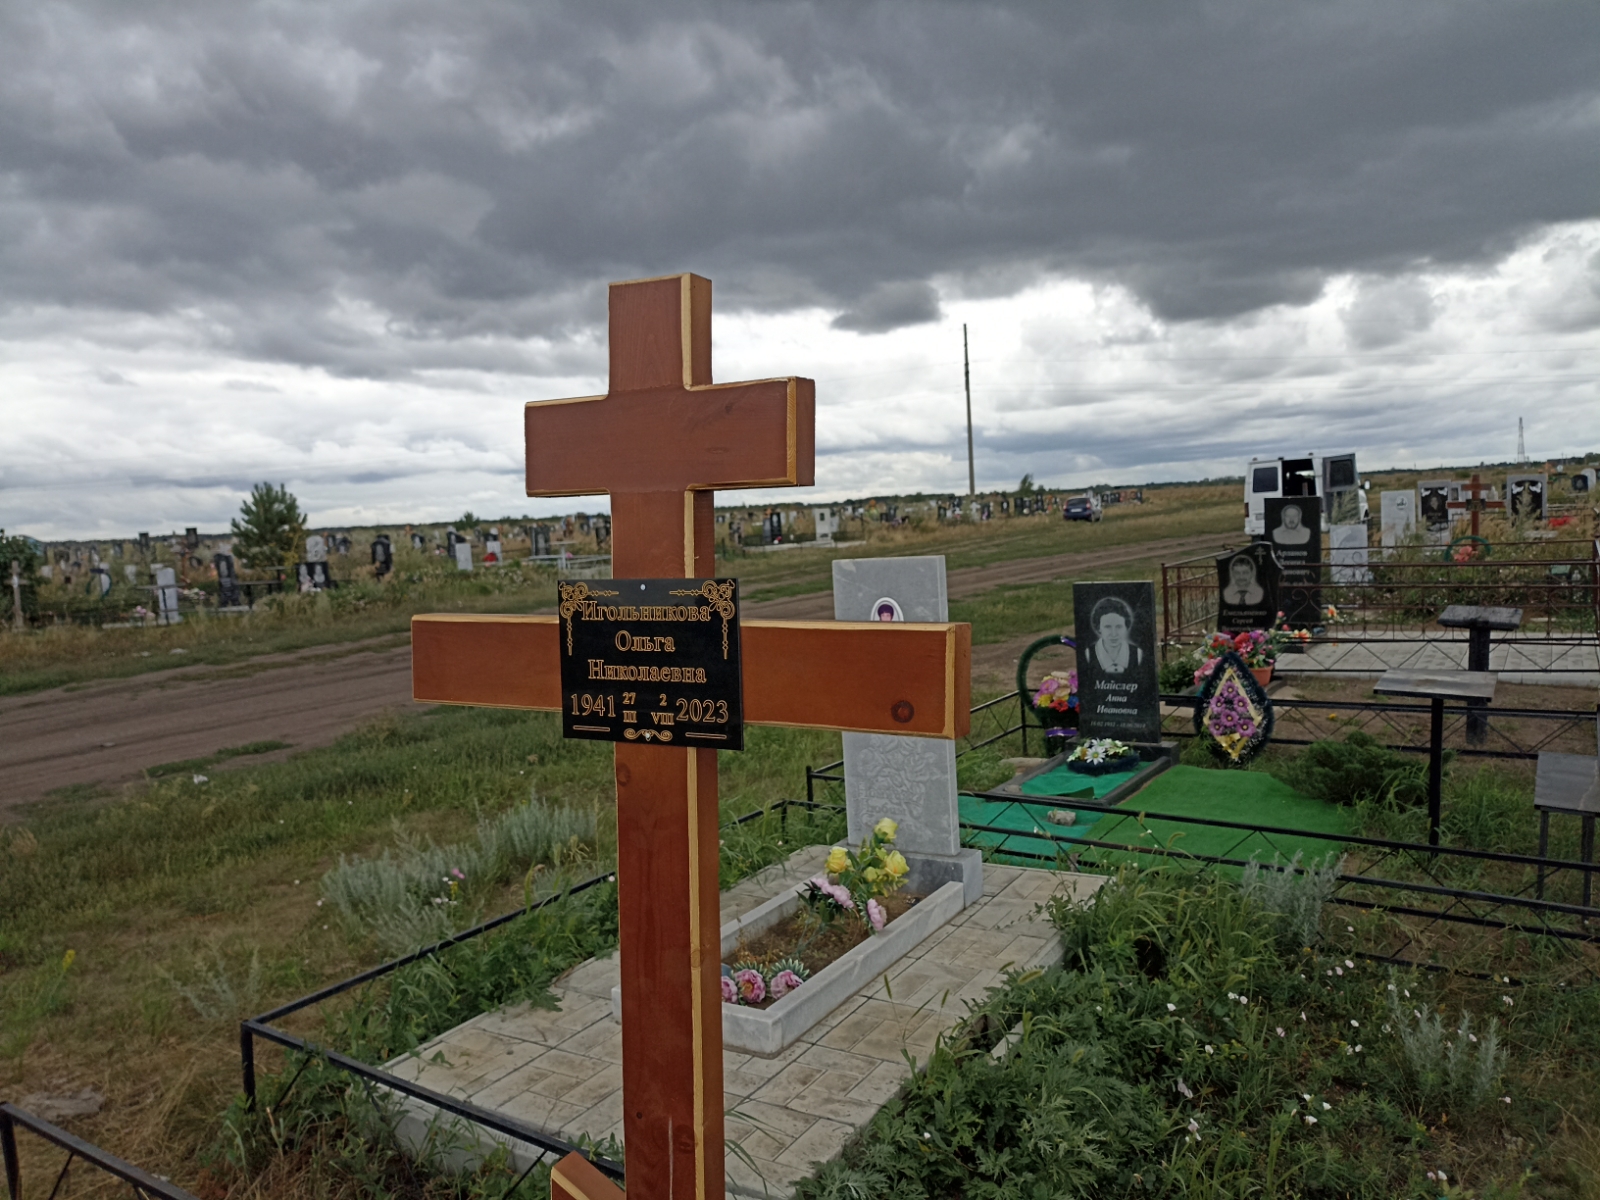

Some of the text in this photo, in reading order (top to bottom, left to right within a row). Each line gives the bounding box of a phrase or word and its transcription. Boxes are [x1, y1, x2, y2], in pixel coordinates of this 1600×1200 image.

[581, 601, 711, 622] Игольникова
[615, 630, 675, 652] Ольга
[588, 659, 707, 684] Николаевна
[1094, 680, 1137, 693] Майслер
[570, 692, 729, 724] 1941 27 2 2023
[1105, 694, 1127, 702] Анна
[1097, 705, 1137, 715] Ивановна
